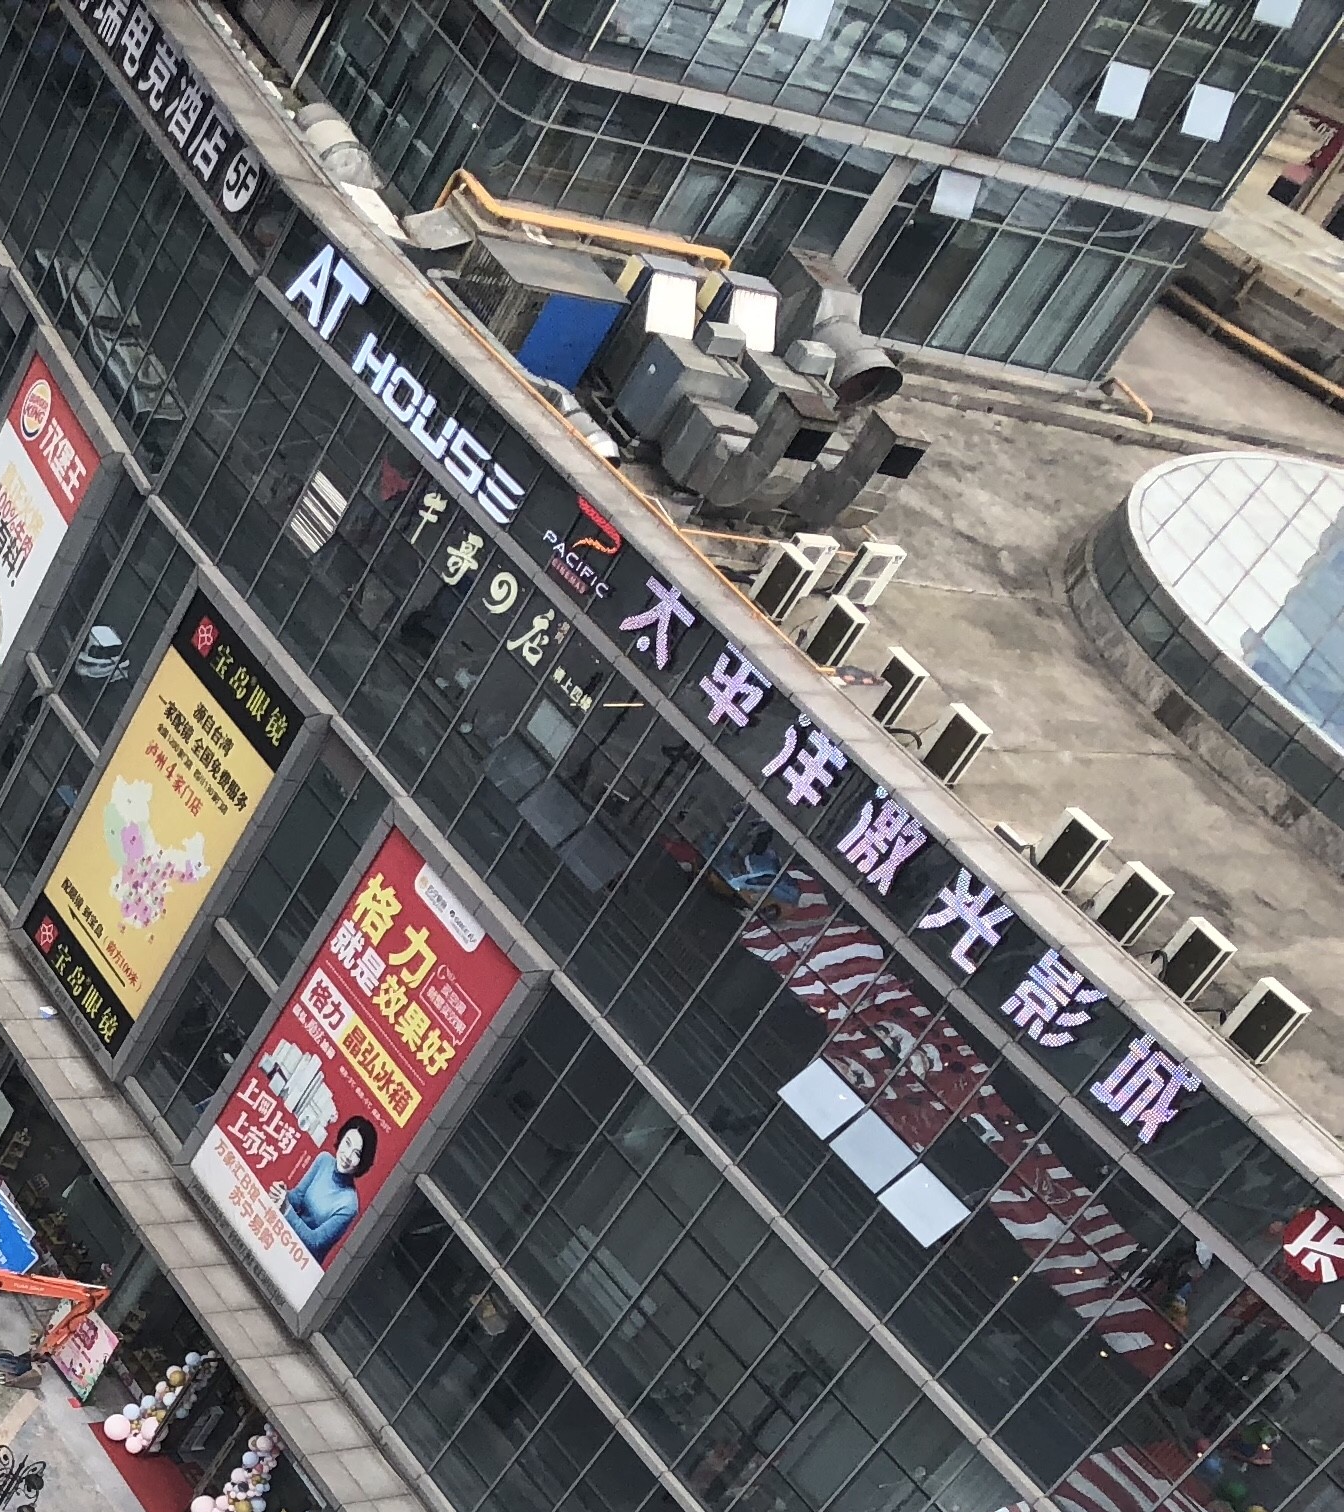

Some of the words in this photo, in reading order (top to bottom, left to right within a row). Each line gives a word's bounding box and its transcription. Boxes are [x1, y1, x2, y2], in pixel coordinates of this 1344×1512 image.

[78, 0, 235, 182] 瑞电竞酒店
[225, 154, 257, 200] 5F
[285, 243, 370, 340] AT
[39, 417, 87, 504] 汉堡王
[351, 332, 525, 524] HOUSE
[543, 530, 610, 600] PACIFIC
[192, 701, 235, 758] 源自台湾
[210, 644, 289, 747] 宝岛眼镜
[144, 739, 204, 818] 泸州4家门店
[159, 694, 195, 745] 一家配镜
[190, 736, 249, 812] 全国免费服务
[619, 576, 1203, 1144] 太平洋激光影城
[351, 872, 438, 989] 格力
[50, 943, 119, 1044] 宝岛眼镜
[330, 918, 456, 1076] 就是效果好
[310, 978, 345, 1031] 格力
[342, 1024, 413, 1116] 晶弘冰箱
[227, 1110, 278, 1169] 上苏宁
[237, 1076, 301, 1155] 上网上街
[229, 1185, 276, 1251] 苏宁易购
